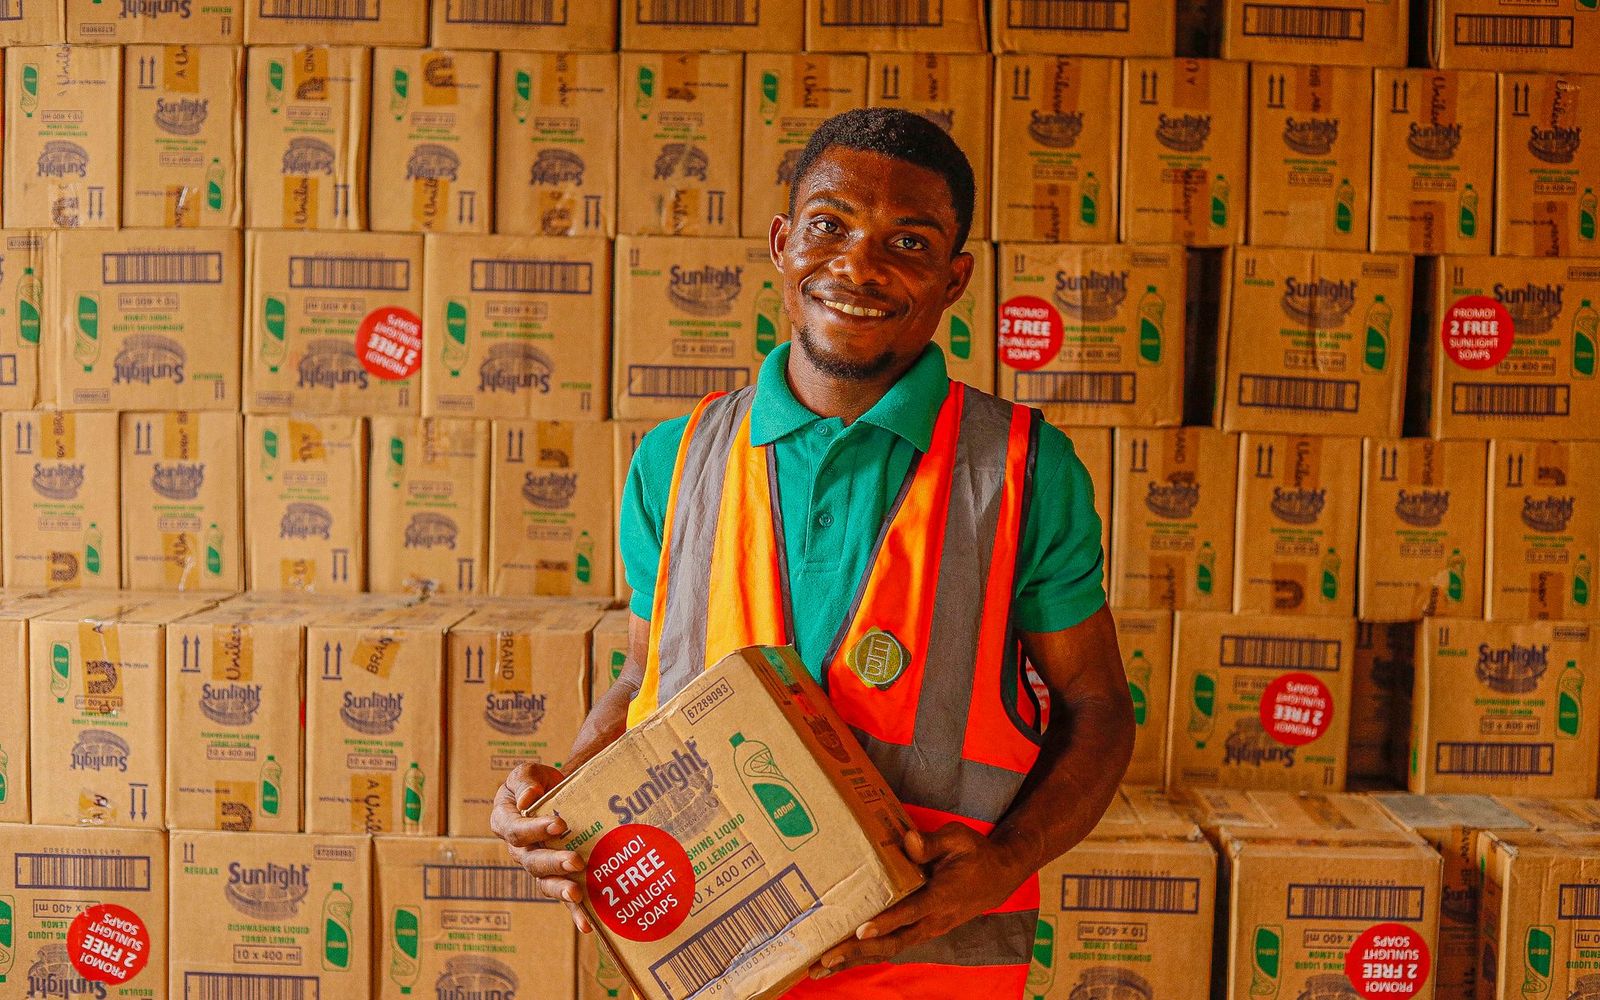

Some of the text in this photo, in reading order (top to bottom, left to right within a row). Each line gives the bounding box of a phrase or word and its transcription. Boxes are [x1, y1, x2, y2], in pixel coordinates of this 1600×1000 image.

[157, 97, 209, 119] Sunlight
[670, 265, 743, 289] Sunlight
[1055, 270, 1128, 297] Sunlight
[1285, 277, 1358, 303] Sunlight
[1494, 285, 1564, 308] Sunlight
[1000, 320, 1050, 335] 2 FREE
[1449, 320, 1500, 336] 2 FREE
[367, 335, 406, 360] FREE
[1458, 349, 1492, 361] SOAPS
[113, 361, 184, 385] Sunlight
[478, 368, 550, 395] Sunlight
[33, 462, 85, 483] Sunlight
[1478, 643, 1549, 667] Sunlight
[202, 684, 263, 704] Sunlight
[343, 692, 403, 711] Sunlight
[486, 694, 547, 713] Sunlight
[687, 683, 731, 720] 67289093
[1273, 705, 1309, 724] FREE
[70, 751, 128, 774] Sunlight
[607, 736, 709, 825] Sunlight
[773, 799, 797, 820] 400ml
[565, 821, 604, 852] REGULAR
[686, 811, 748, 862] SHING LIQUID
[593, 834, 647, 883] PROMO!
[709, 837, 741, 868] LEMON
[228, 861, 310, 891] Sunlight
[601, 848, 665, 907] 2 FREE
[715, 864, 740, 888] 400
[742, 850, 760, 871] ml
[53, 903, 72, 912] 400
[616, 869, 677, 924] SUNLIGHT
[103, 914, 140, 935] SOAPS
[637, 893, 679, 932] SOAPS
[87, 922, 144, 951] SUNLIGHT
[1323, 933, 1344, 944] 400
[1373, 936, 1411, 947] SOAPS
[81, 935, 138, 968] 2 FREE
[237, 952, 250, 962] 10
[263, 953, 284, 964] 400
[1362, 949, 1420, 961] SUNLIGHT
[79, 953, 128, 979] PROMO!
[1362, 963, 1418, 979] 2 FREE
[27, 975, 108, 1000] Sunlight
[1365, 981, 1413, 993] PROMO!
